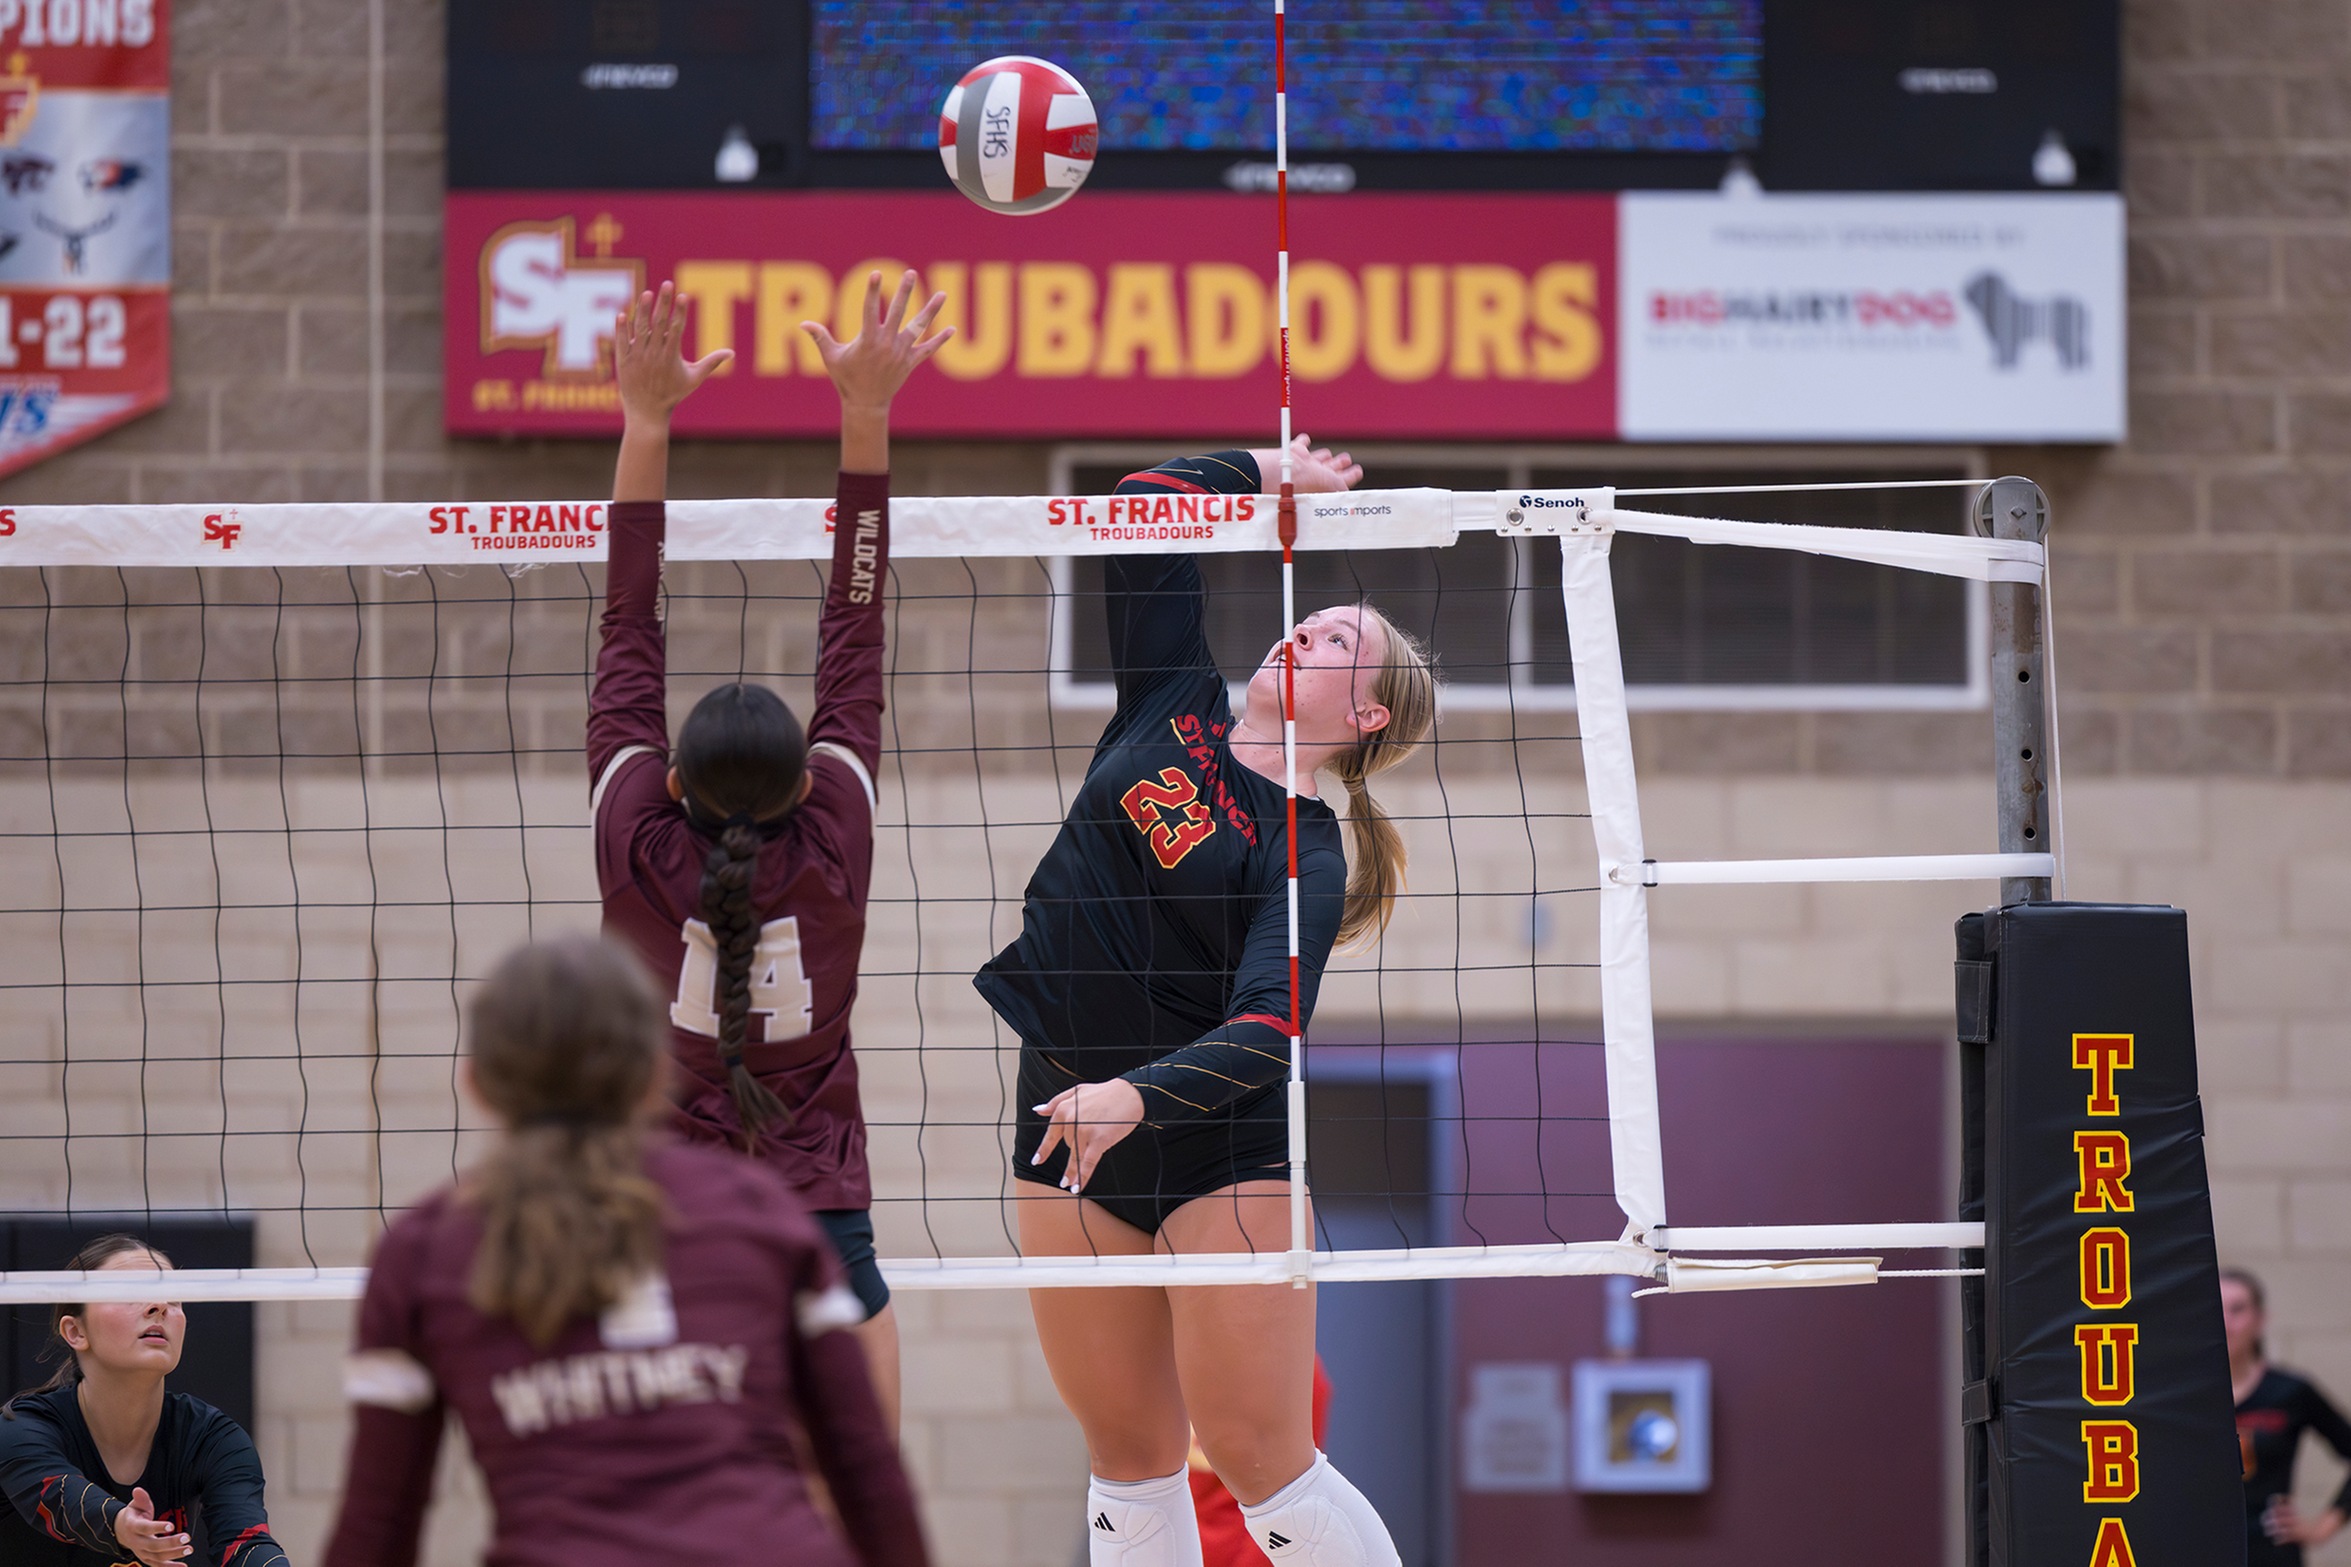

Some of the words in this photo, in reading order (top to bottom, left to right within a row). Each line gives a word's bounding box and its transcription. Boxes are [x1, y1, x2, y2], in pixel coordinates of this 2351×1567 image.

[984, 106, 1011, 159] SFHS
[480, 217, 645, 377] SF
[428, 506, 478, 534] ST.
[489, 505, 612, 533] FRANC
[1048, 498, 1096, 525] ST.
[1108, 496, 1255, 524] FRANCIS
[1314, 506, 1349, 518] sports
[1534, 496, 1585, 508] Senoh
[203, 514, 241, 549] SF
[471, 535, 596, 550] TROUBADOURS
[1090, 526, 1214, 540] TROUBADOURS
[849, 510, 881, 605] WILDCATS
[1120, 766, 1217, 870] 23
[669, 915, 813, 1043] 14
[2072, 1033, 2140, 1567] TROUBA
[491, 1343, 748, 1439] WHITNEY
